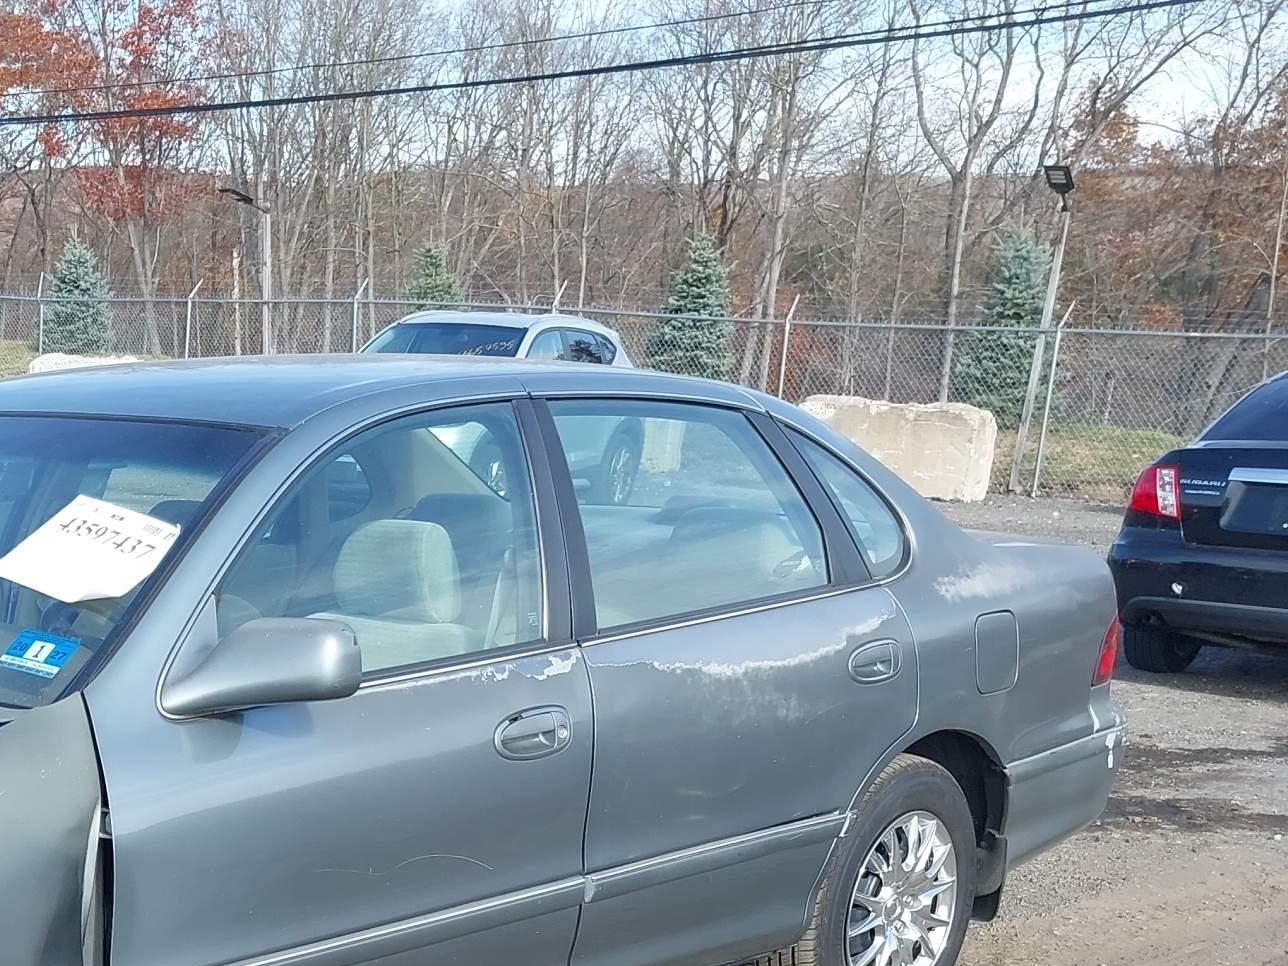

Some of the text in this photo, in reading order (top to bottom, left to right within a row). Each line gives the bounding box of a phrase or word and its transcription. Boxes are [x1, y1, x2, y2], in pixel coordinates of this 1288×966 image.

[1180, 479, 1226, 487] SUBARU
[59, 515, 158, 560] 43597437
[13, 641, 67, 660] 20 1 27
